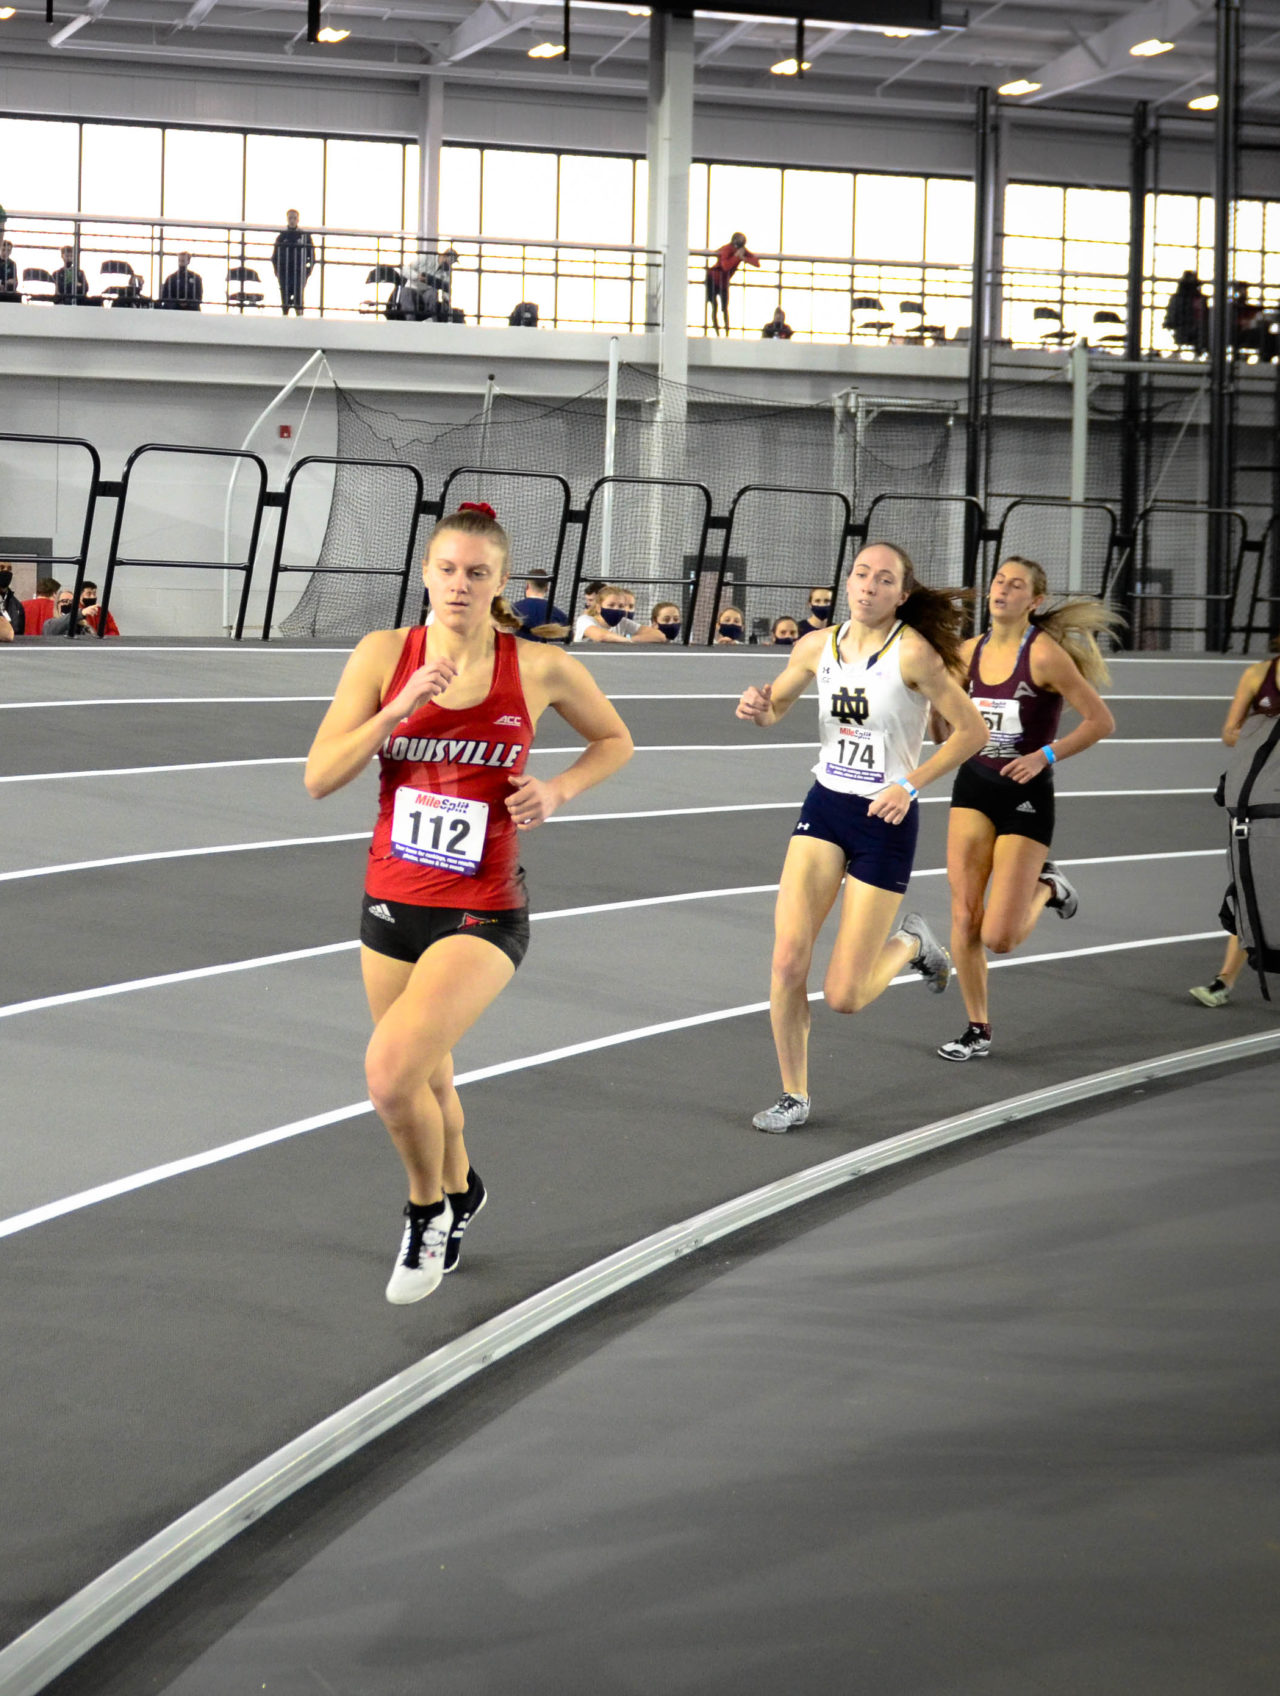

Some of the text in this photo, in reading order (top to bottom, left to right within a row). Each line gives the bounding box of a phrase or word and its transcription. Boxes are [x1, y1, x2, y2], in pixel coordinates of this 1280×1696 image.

[493, 715, 521, 727] ACC
[839, 727, 872, 740] MileSplit
[382, 735, 523, 768] LOUISVILLE
[837, 739, 875, 769] 174
[415, 794, 469, 814] MileSplit
[409, 810, 471, 856] 112
